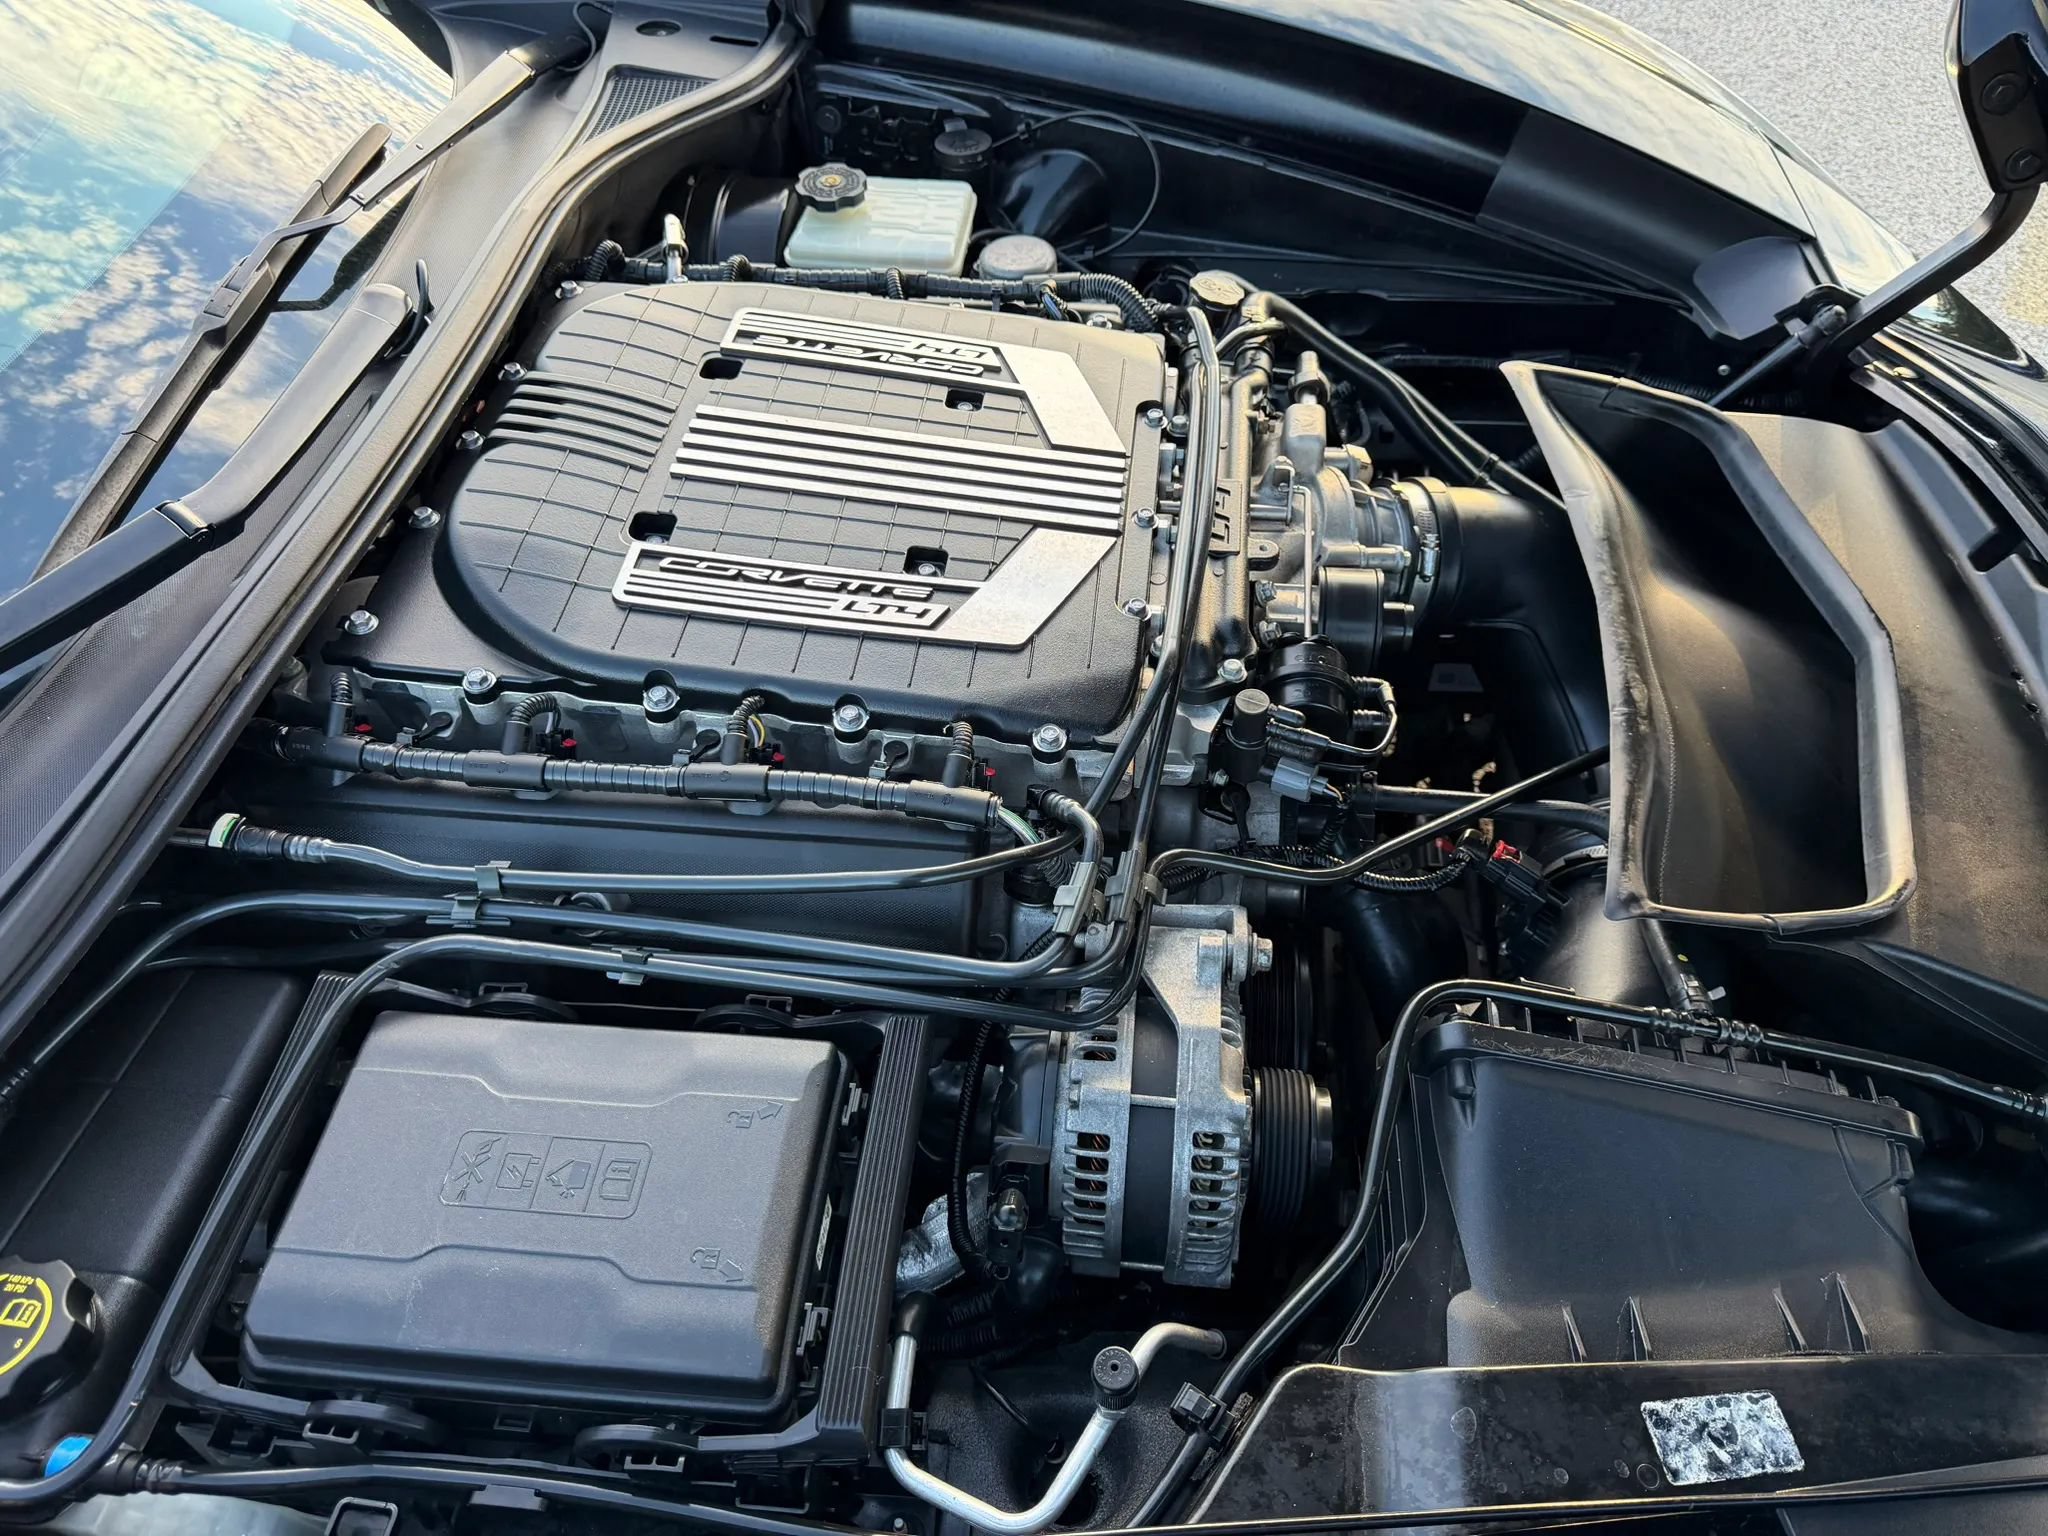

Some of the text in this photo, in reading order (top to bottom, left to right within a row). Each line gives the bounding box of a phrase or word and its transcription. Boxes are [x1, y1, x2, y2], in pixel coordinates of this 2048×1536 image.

[752, 333, 985, 377] CORVETTE
[912, 341, 989, 360] LT4
[658, 555, 934, 599] CORVETTE
[841, 598, 930, 620] LT4
[13, 1283, 28, 1293] PSI
